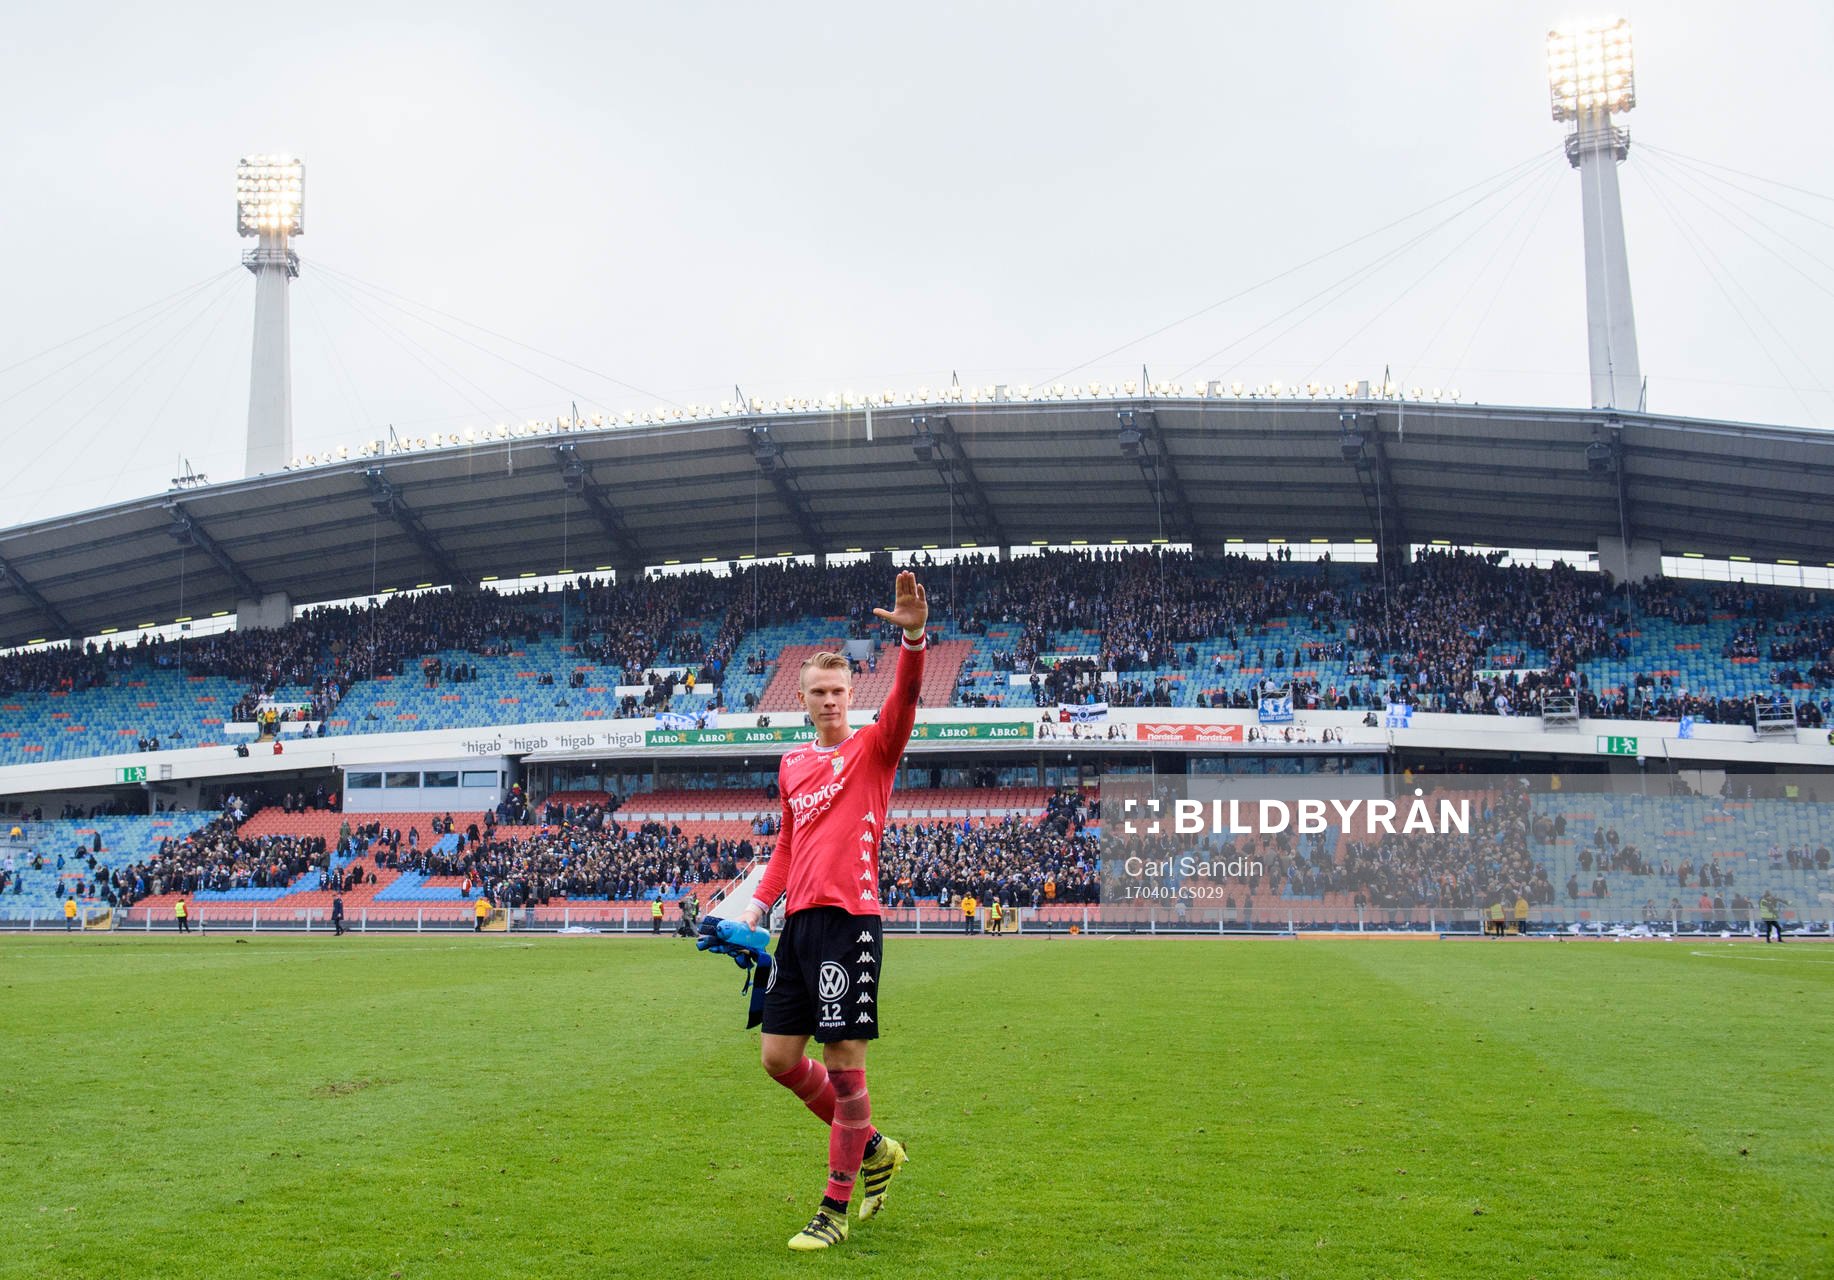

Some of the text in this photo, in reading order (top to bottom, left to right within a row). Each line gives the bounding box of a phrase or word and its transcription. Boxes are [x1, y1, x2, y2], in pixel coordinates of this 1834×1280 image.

[467, 739, 501, 755] higab
[514, 736, 548, 752] higab
[561, 735, 595, 750] higab
[608, 733, 641, 748] higab
[821, 1003, 842, 1021] 12
